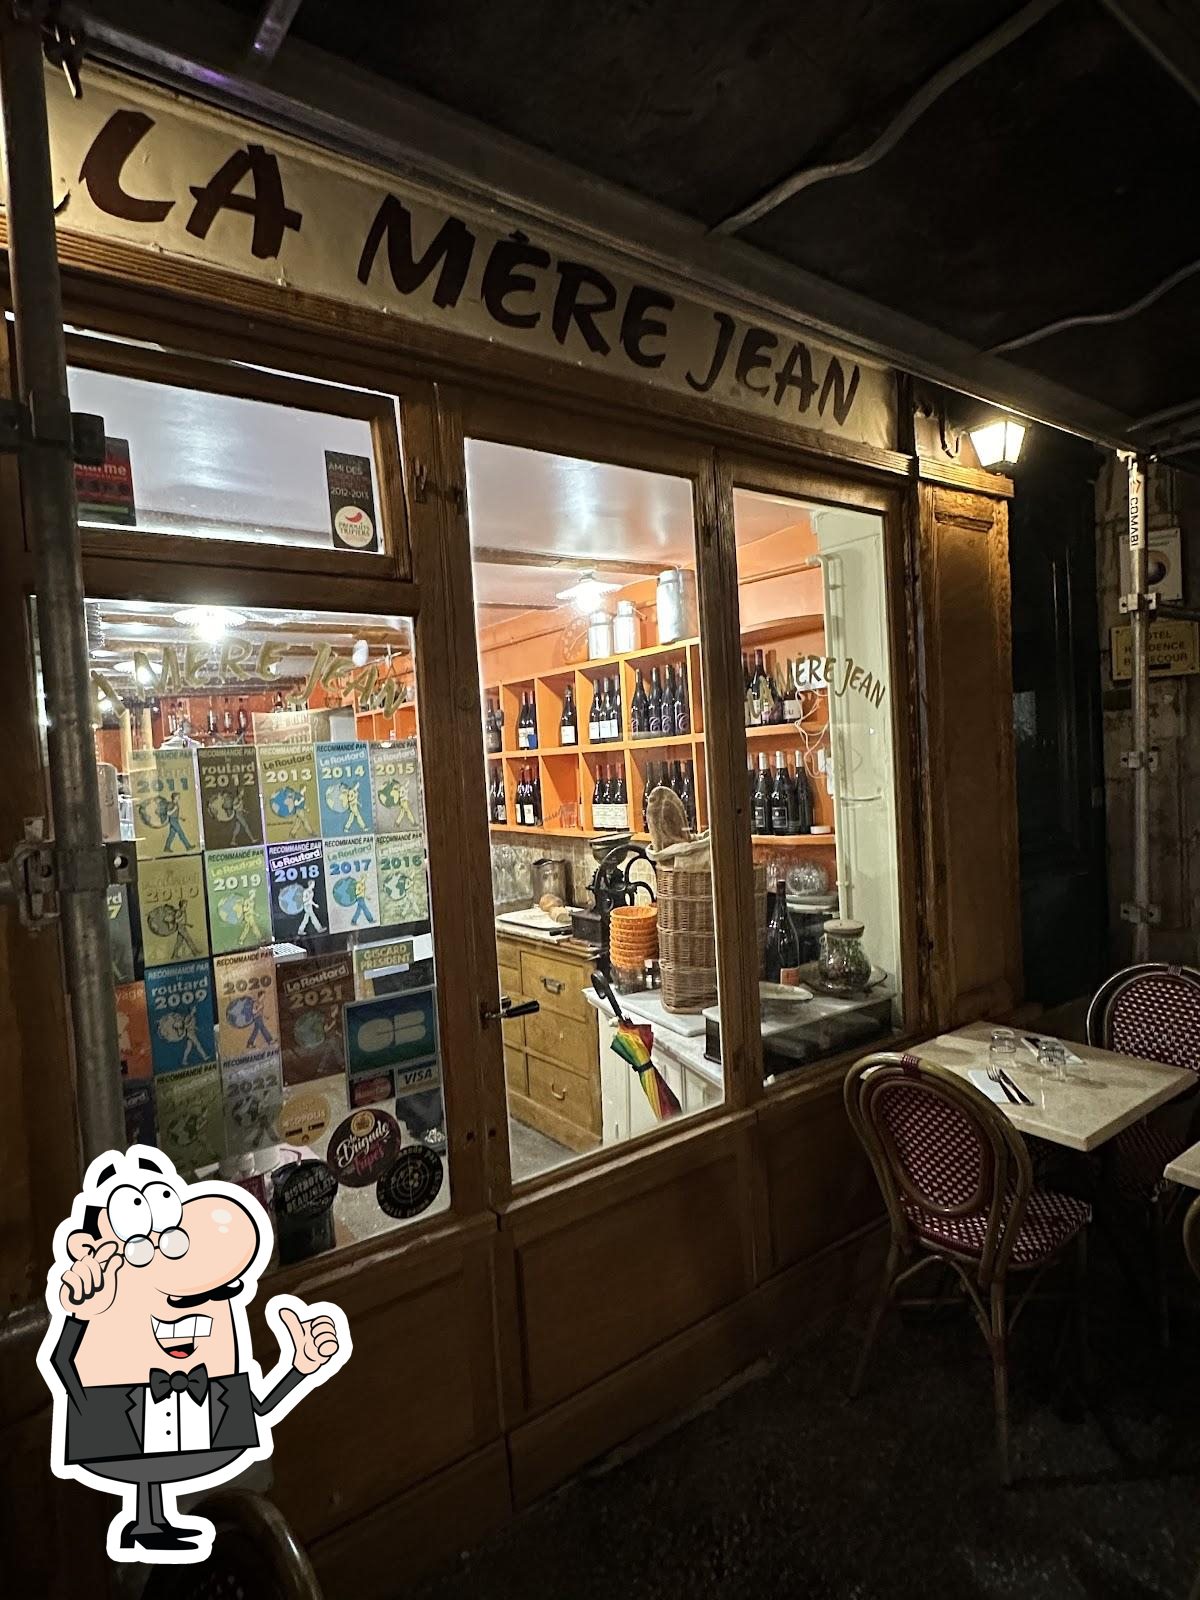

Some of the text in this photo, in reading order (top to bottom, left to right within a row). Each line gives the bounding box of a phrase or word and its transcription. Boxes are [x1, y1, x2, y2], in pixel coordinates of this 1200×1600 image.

[79, 109, 860, 426] LA MÈRE JEAN
[1130, 496, 1139, 546] COMABI
[286, 640, 407, 719] JEAN
[835, 658, 885, 709] JEAN
[202, 761, 255, 775] routard
[266, 768, 312, 783] 2013
[322, 765, 364, 779] 2014
[376, 763, 414, 776] 2015
[205, 773, 254, 788] 2012
[363, 836, 374, 844] PAR
[330, 859, 371, 875] 2017
[381, 856, 422, 870] 2016
[274, 865, 319, 882] 2018
[213, 874, 261, 891] 2019
[144, 885, 199, 903] 2010
[364, 944, 407, 961] GISCARD
[152, 976, 208, 997] routard
[223, 975, 272, 995] 2020
[154, 989, 208, 1010] 2009
[288, 984, 343, 1010] 2021
[405, 1068, 432, 1084] VISA
